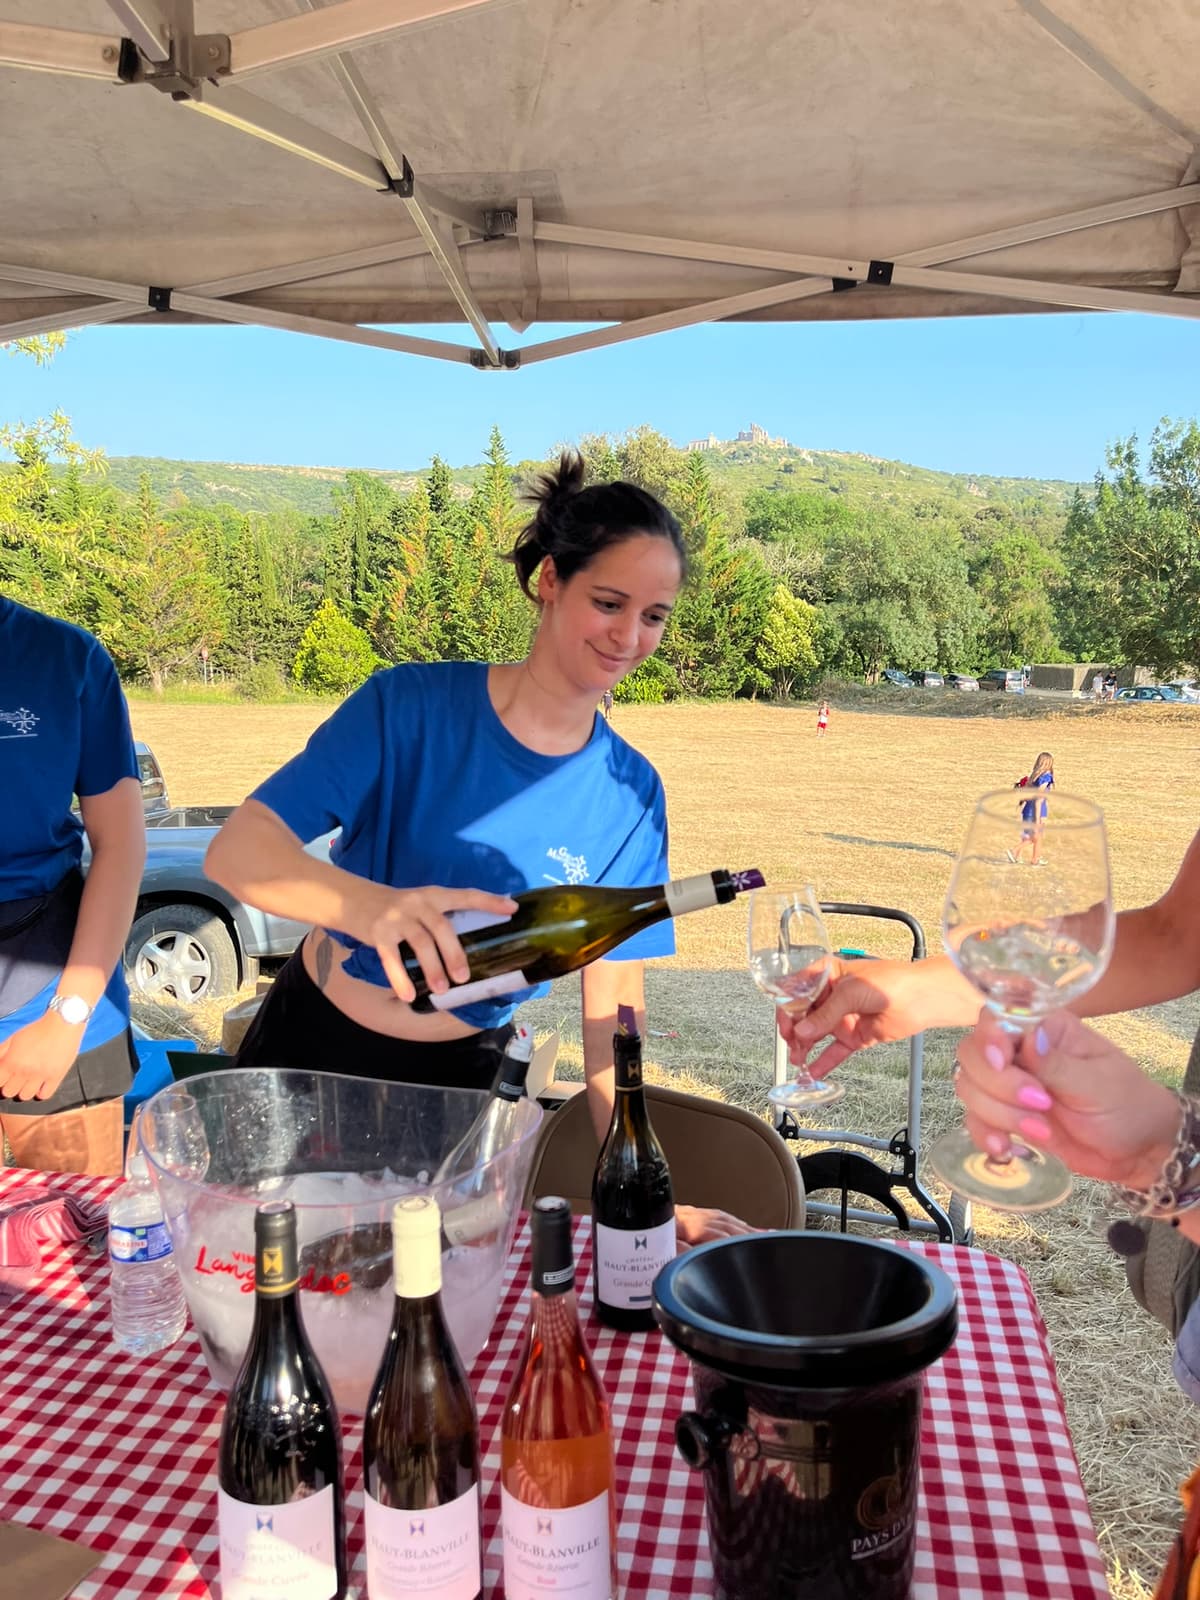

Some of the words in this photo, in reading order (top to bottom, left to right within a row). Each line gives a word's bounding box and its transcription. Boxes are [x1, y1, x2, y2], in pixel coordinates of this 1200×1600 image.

[194, 1245, 352, 1295] Langdoc
[370, 1529, 472, 1560] HAUT-BLANVILLE
[504, 1528, 600, 1559] HAUT-BLANVILLE
[852, 1528, 889, 1553] PAYS
